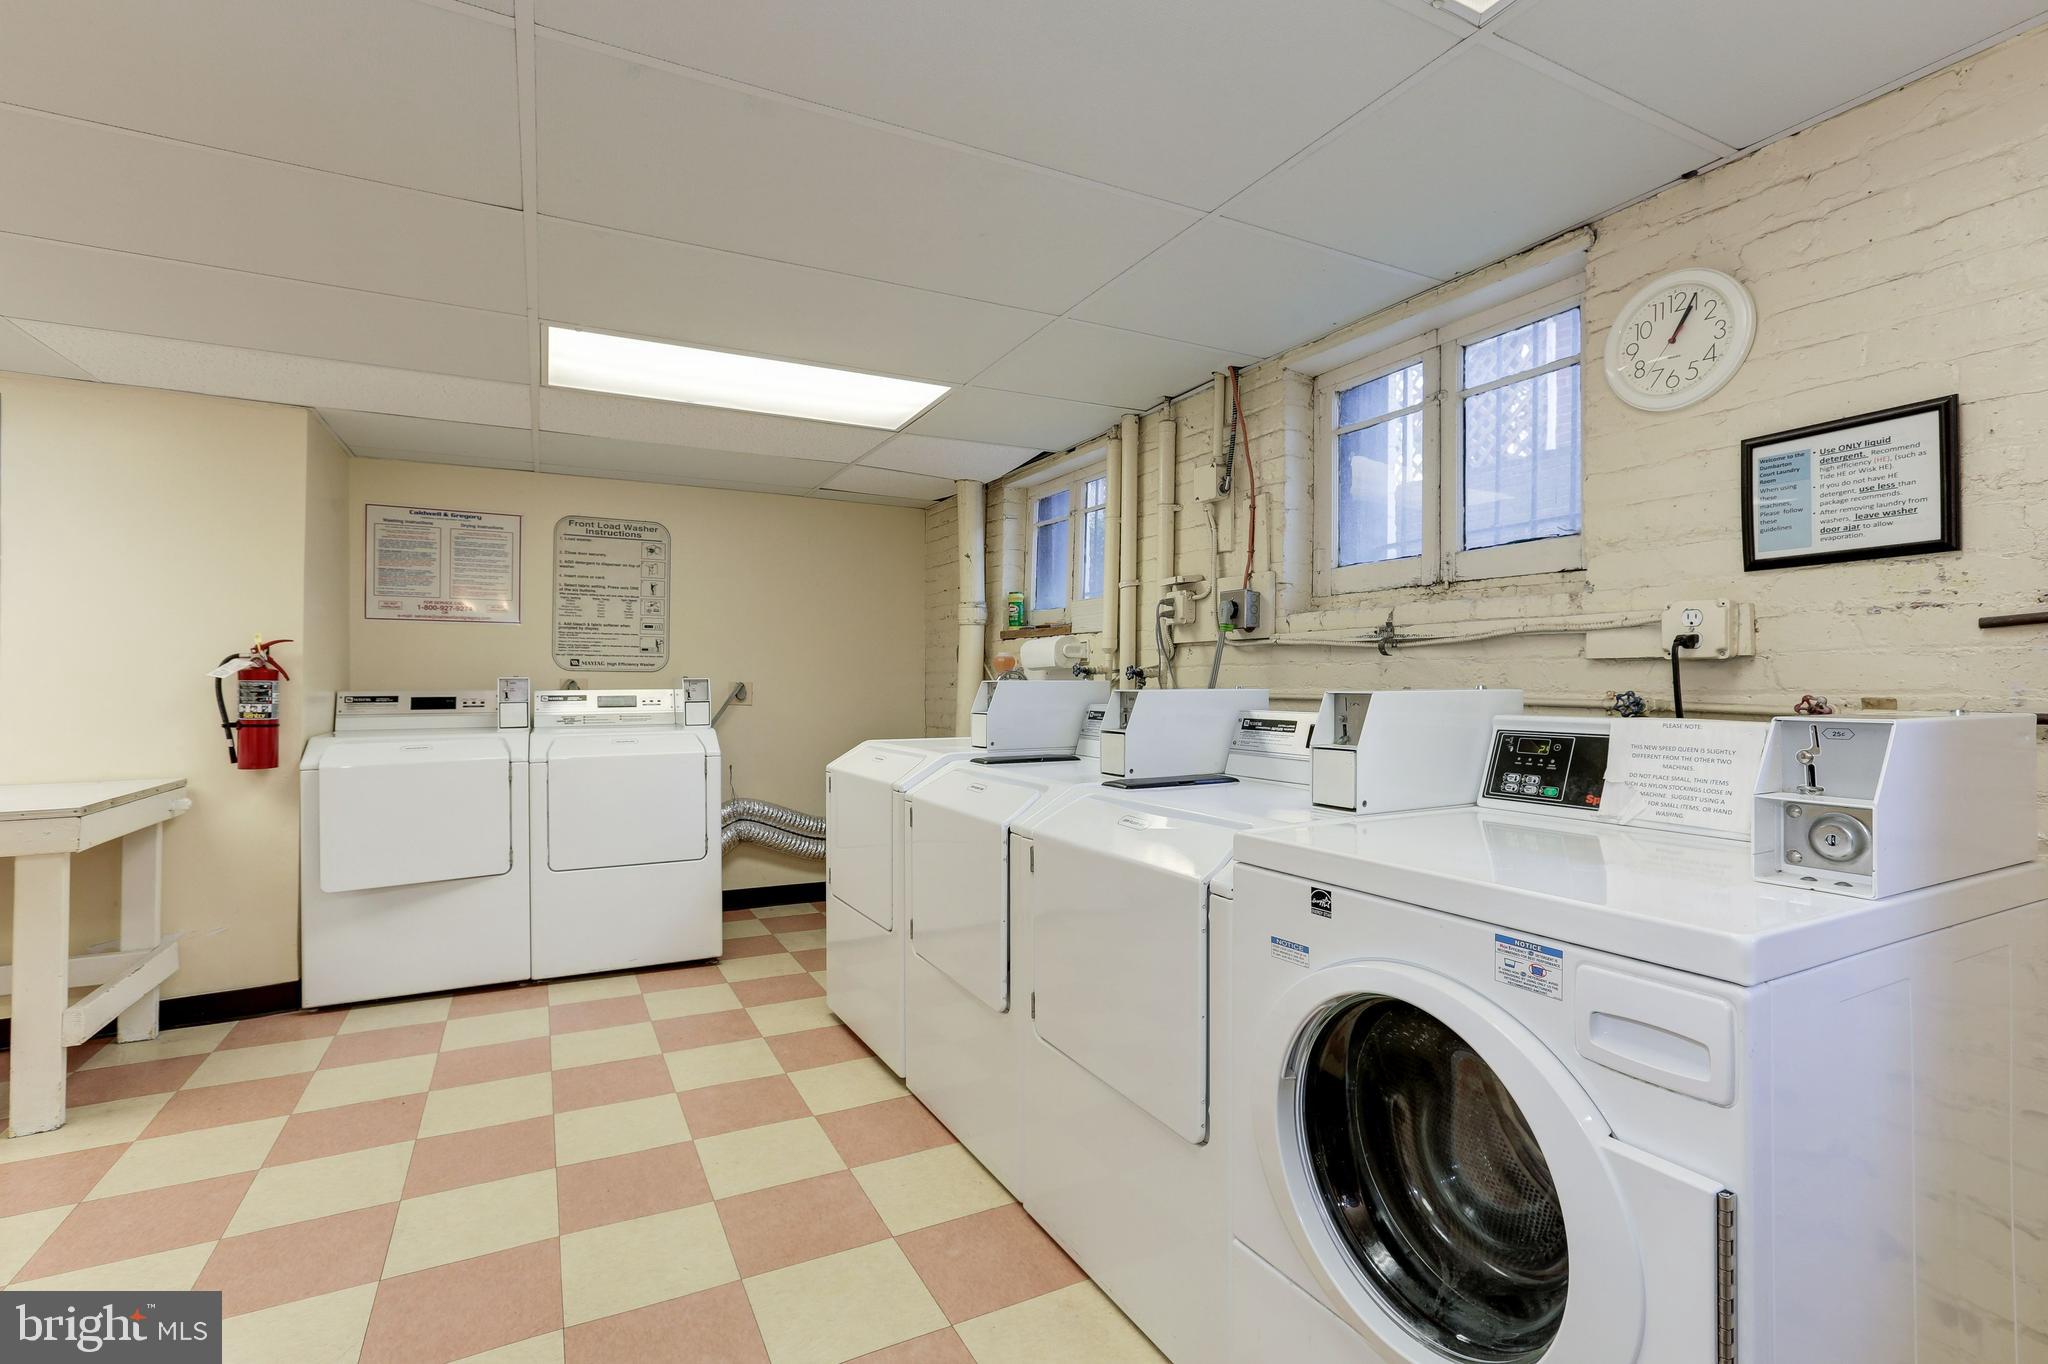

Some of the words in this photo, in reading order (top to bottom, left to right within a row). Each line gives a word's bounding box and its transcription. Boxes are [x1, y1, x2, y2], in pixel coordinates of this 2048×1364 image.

[1668, 292, 1688, 314] 12
[1704, 300, 1717, 320] 2
[1652, 302, 1665, 322] 11
[1634, 320, 1652, 342] 10
[1713, 320, 1726, 340] 3
[1626, 342, 1640, 362] 9
[1702, 342, 1717, 362] 4
[1634, 360, 1646, 378] 8
[1685, 360, 1699, 380] 5
[1650, 368, 1664, 388] 7
[1666, 369, 1680, 388] 6
[1820, 448, 1836, 456] Use
[1838, 441, 1862, 452] ONLY
[1864, 436, 1892, 447] liquid
[1820, 452, 1866, 464] detergent.
[1871, 442, 1920, 455] Recommend
[1760, 456, 1786, 464] Welcome
[1760, 462, 1792, 470] Dumbarton
[1836, 459, 1872, 470] efficiency
[1894, 452, 1916, 460] (such
[1776, 467, 1800, 475] Laundry
[1877, 482, 1896, 490] less
[1820, 498, 1849, 507] package
[1840, 504, 1875, 513] removing
[1876, 500, 1906, 508] laundry
[1855, 512, 1880, 520] leave
[1882, 506, 1918, 517] washer
[568, 520, 594, 528] Front
[598, 522, 620, 530] Load
[623, 524, 658, 533] Washer
[585, 528, 642, 538] Instructions
[1760, 526, 1792, 534] guidelines
[1820, 526, 1840, 534] door
[1842, 524, 1860, 532] ajar
[1662, 764, 1695, 772] MACHINES.
[1668, 784, 1702, 793] STOCKINGS
[1276, 939, 1304, 952] NOTICE
[1514, 940, 1542, 951] NOTICE
